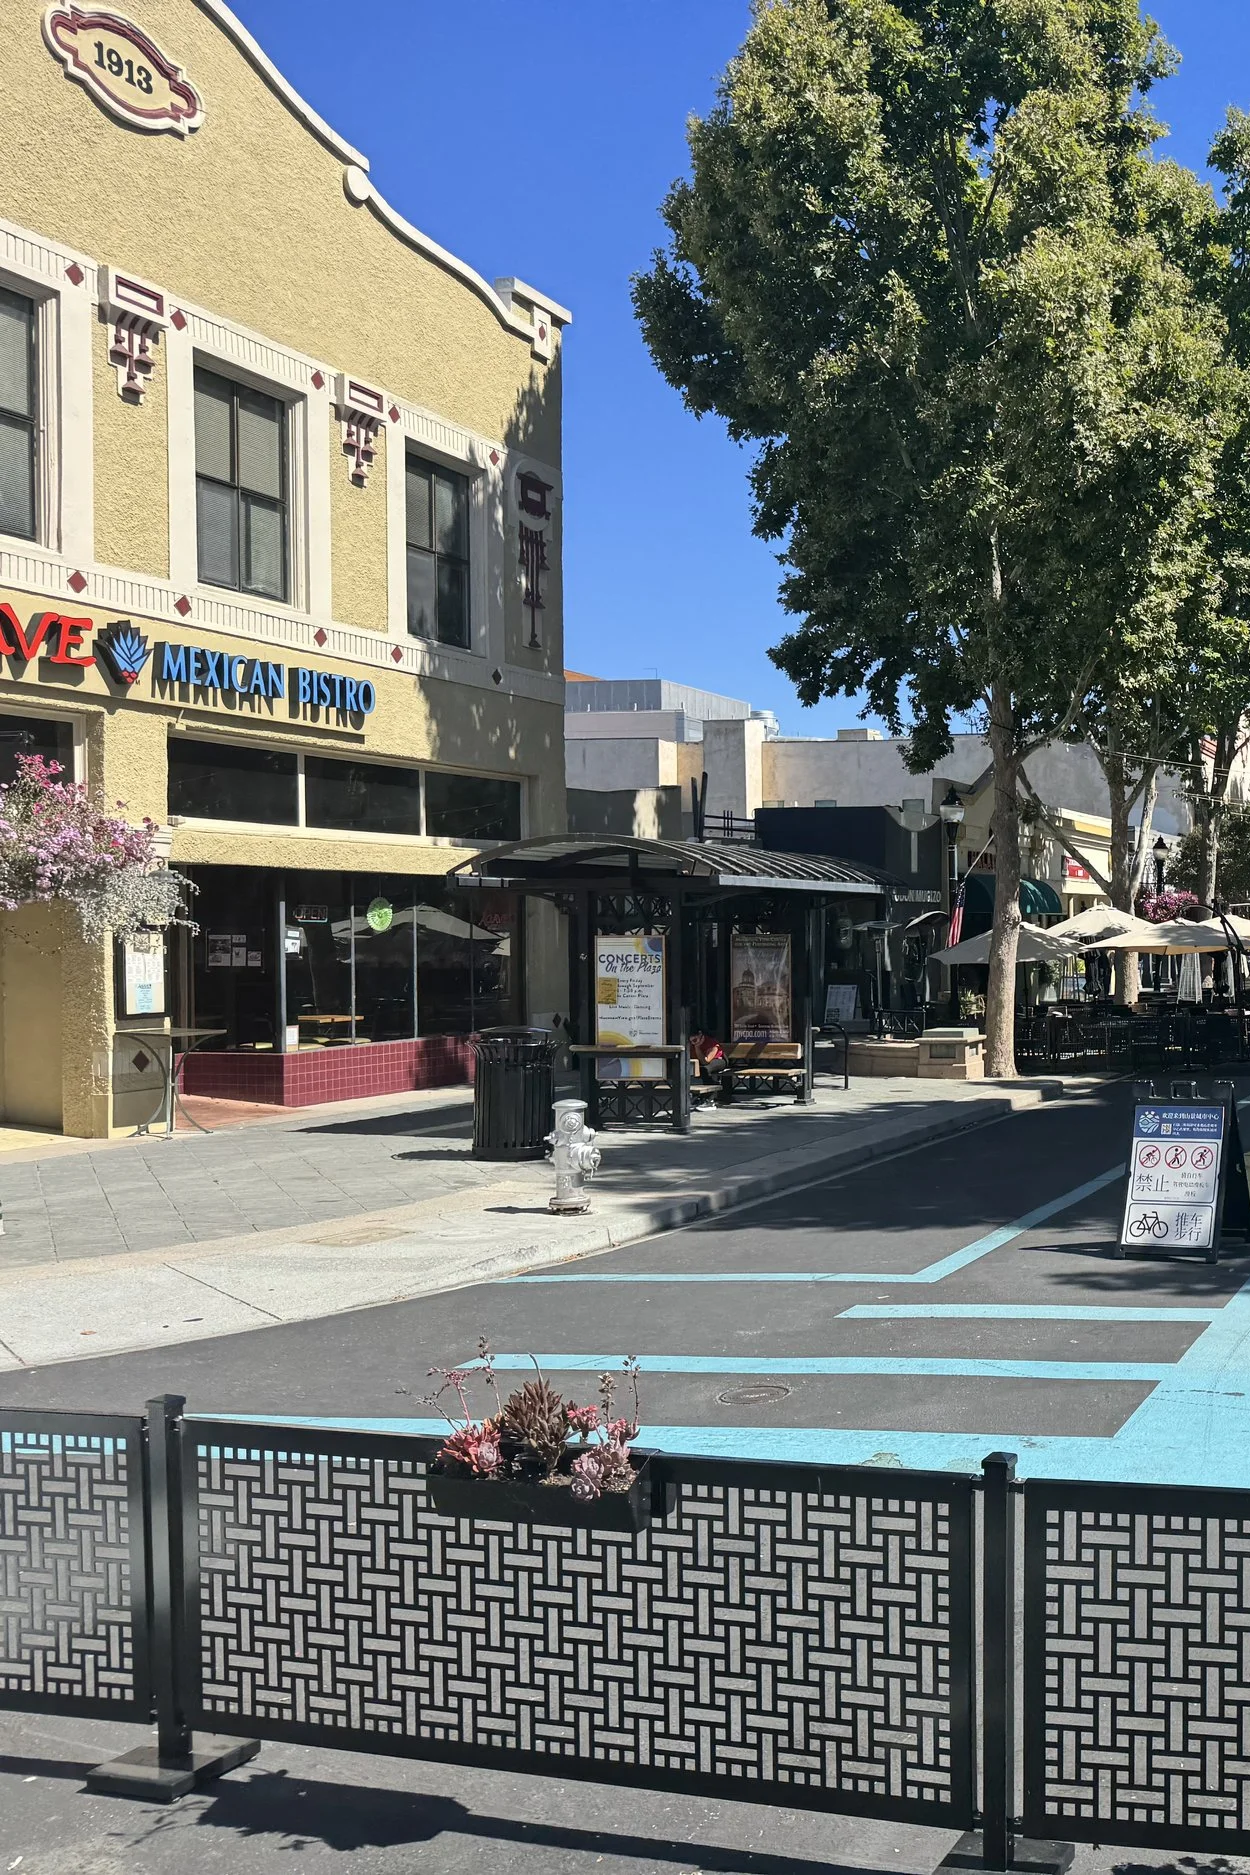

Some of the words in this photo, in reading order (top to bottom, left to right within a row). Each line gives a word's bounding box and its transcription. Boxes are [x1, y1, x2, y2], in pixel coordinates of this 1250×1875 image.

[94, 41, 153, 94] 1913
[163, 641, 286, 699] MEXICAN
[299, 667, 376, 715] BISTRO
[598, 954, 661, 963] CONCERTS
[605, 962, 617, 974] On
[619, 961, 635, 973] the
[636, 961, 662, 975] Plaza
[734, 1030, 767, 1040] mvcpa.com
[1135, 1173, 1170, 1193] 禁止
[1175, 1211, 1203, 1228] 推车
[1174, 1225, 1203, 1242] 步行
